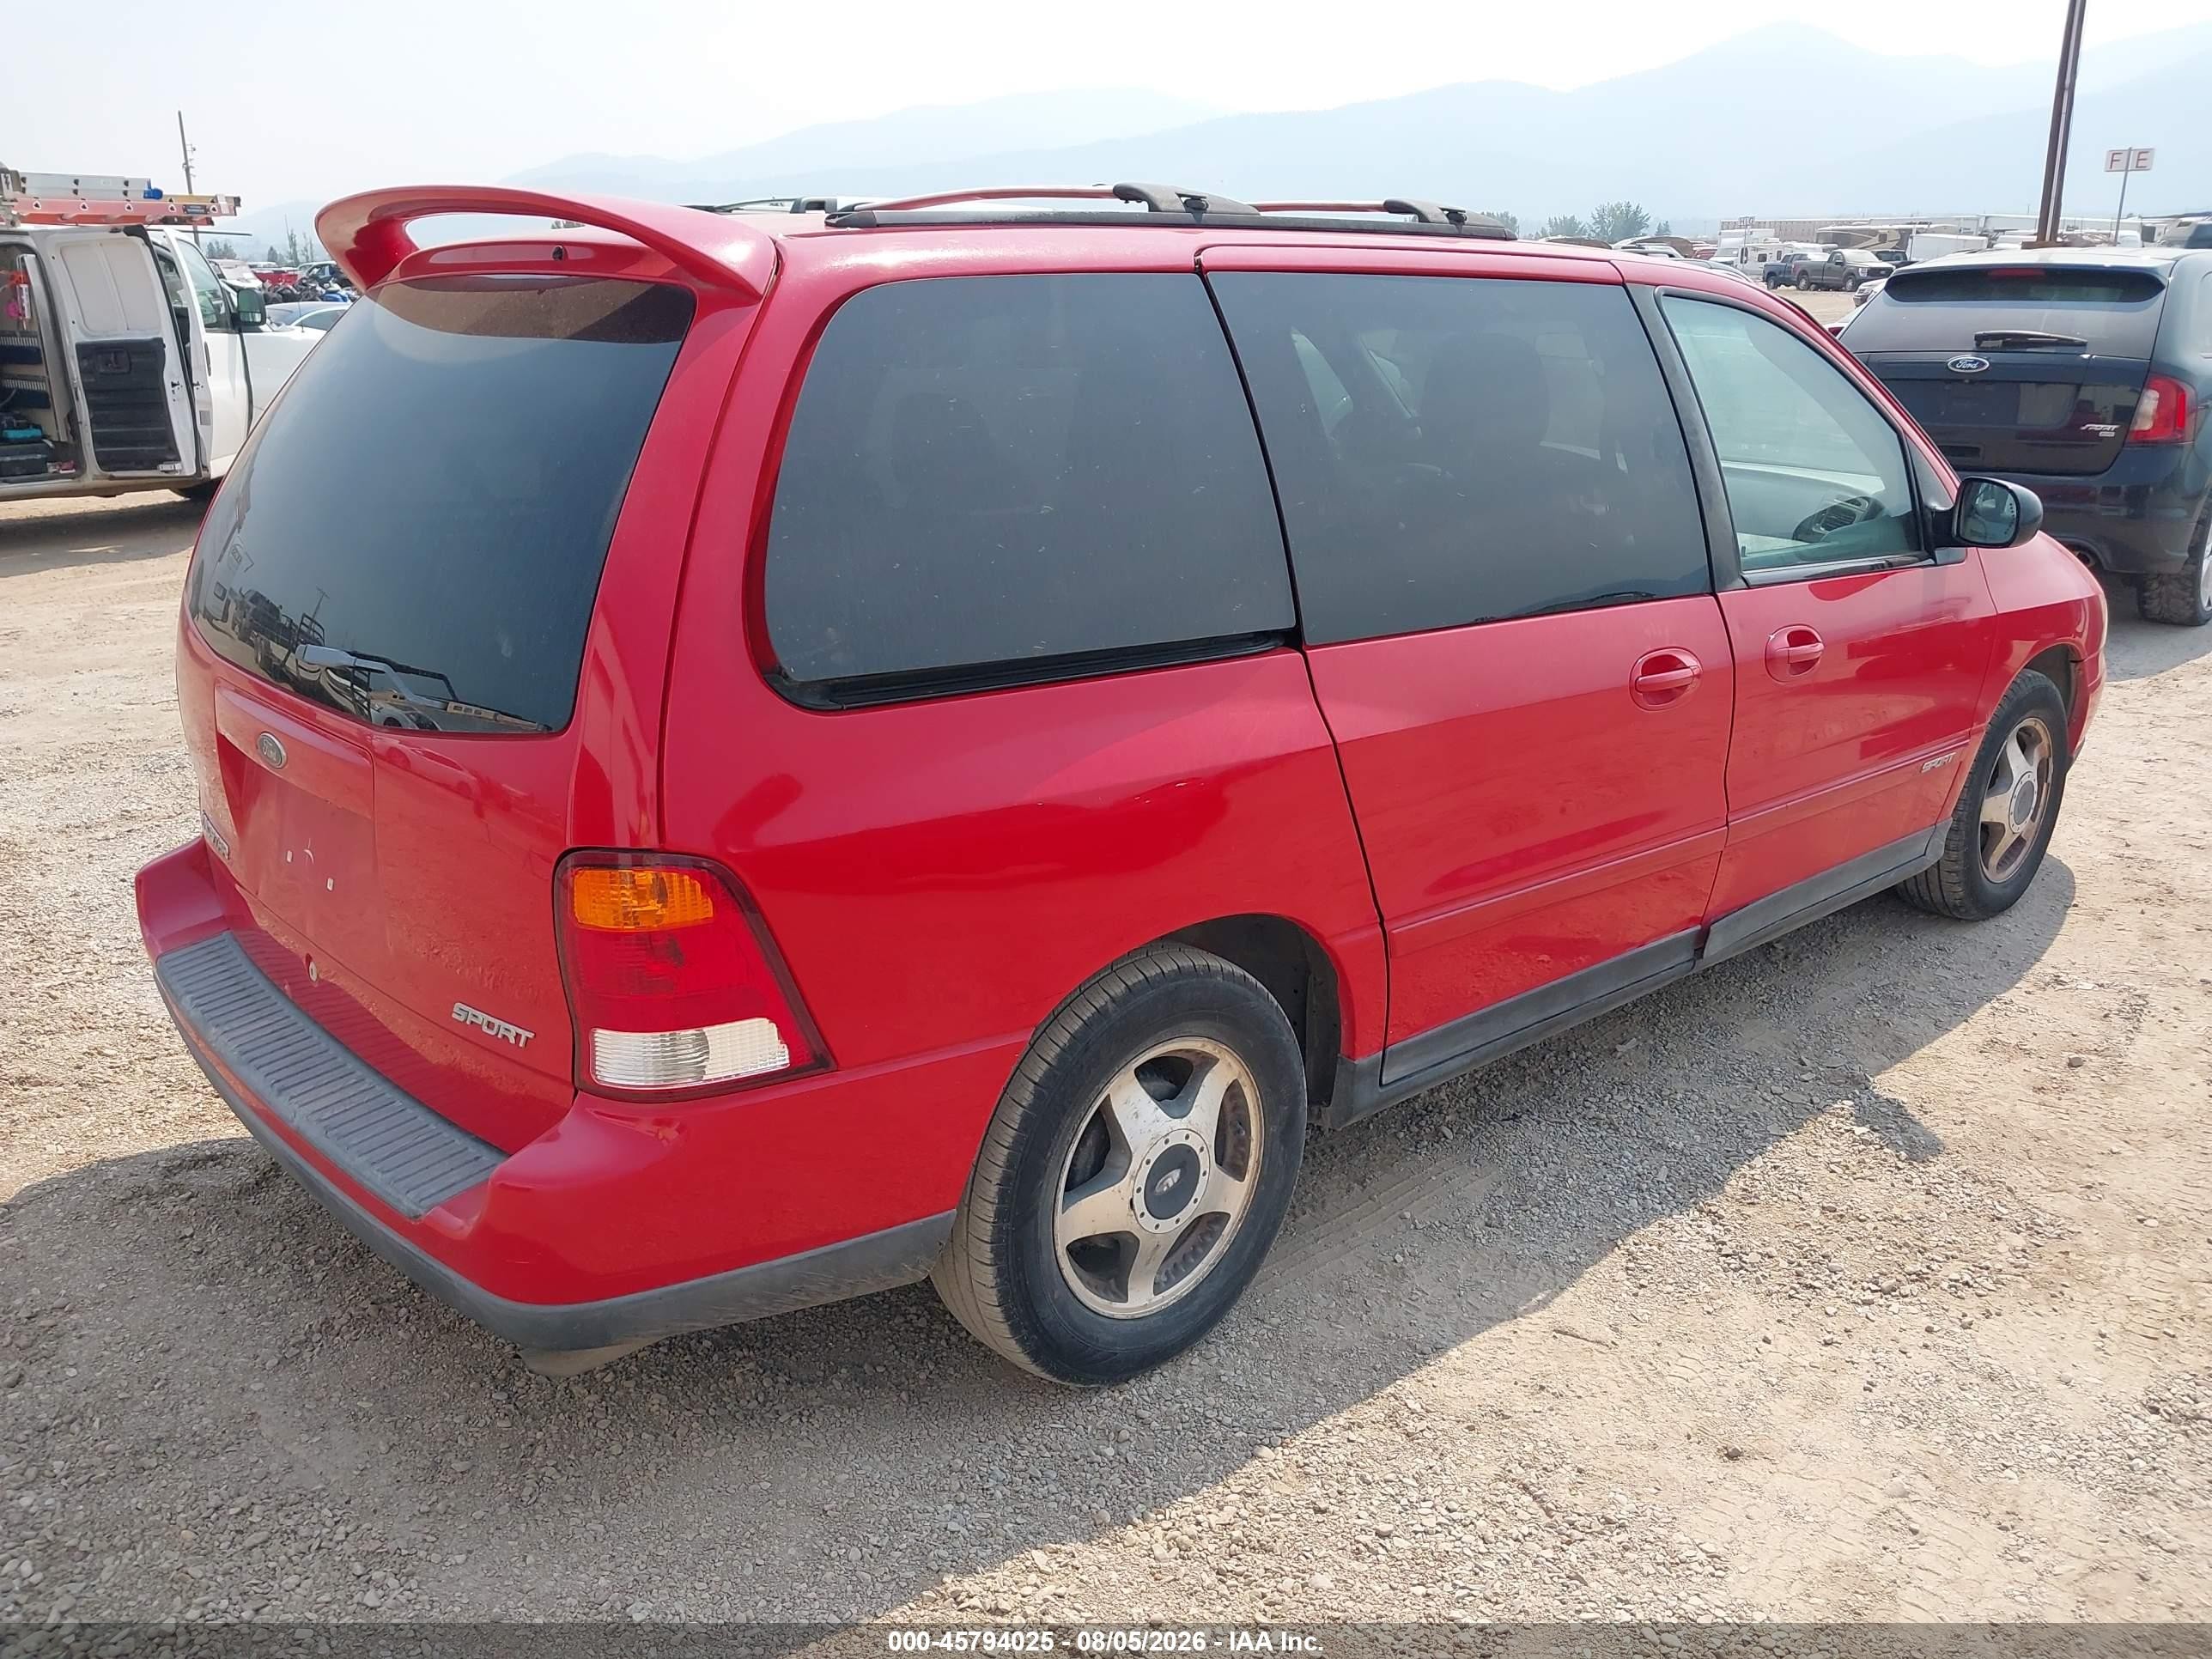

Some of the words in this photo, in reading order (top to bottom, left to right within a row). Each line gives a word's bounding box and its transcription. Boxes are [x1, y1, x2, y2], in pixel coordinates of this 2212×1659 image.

[2109, 152, 2124, 170] F
[2135, 151, 2150, 169] E
[1921, 751, 1957, 774] SPORT
[451, 1001, 536, 1048] SPORT
